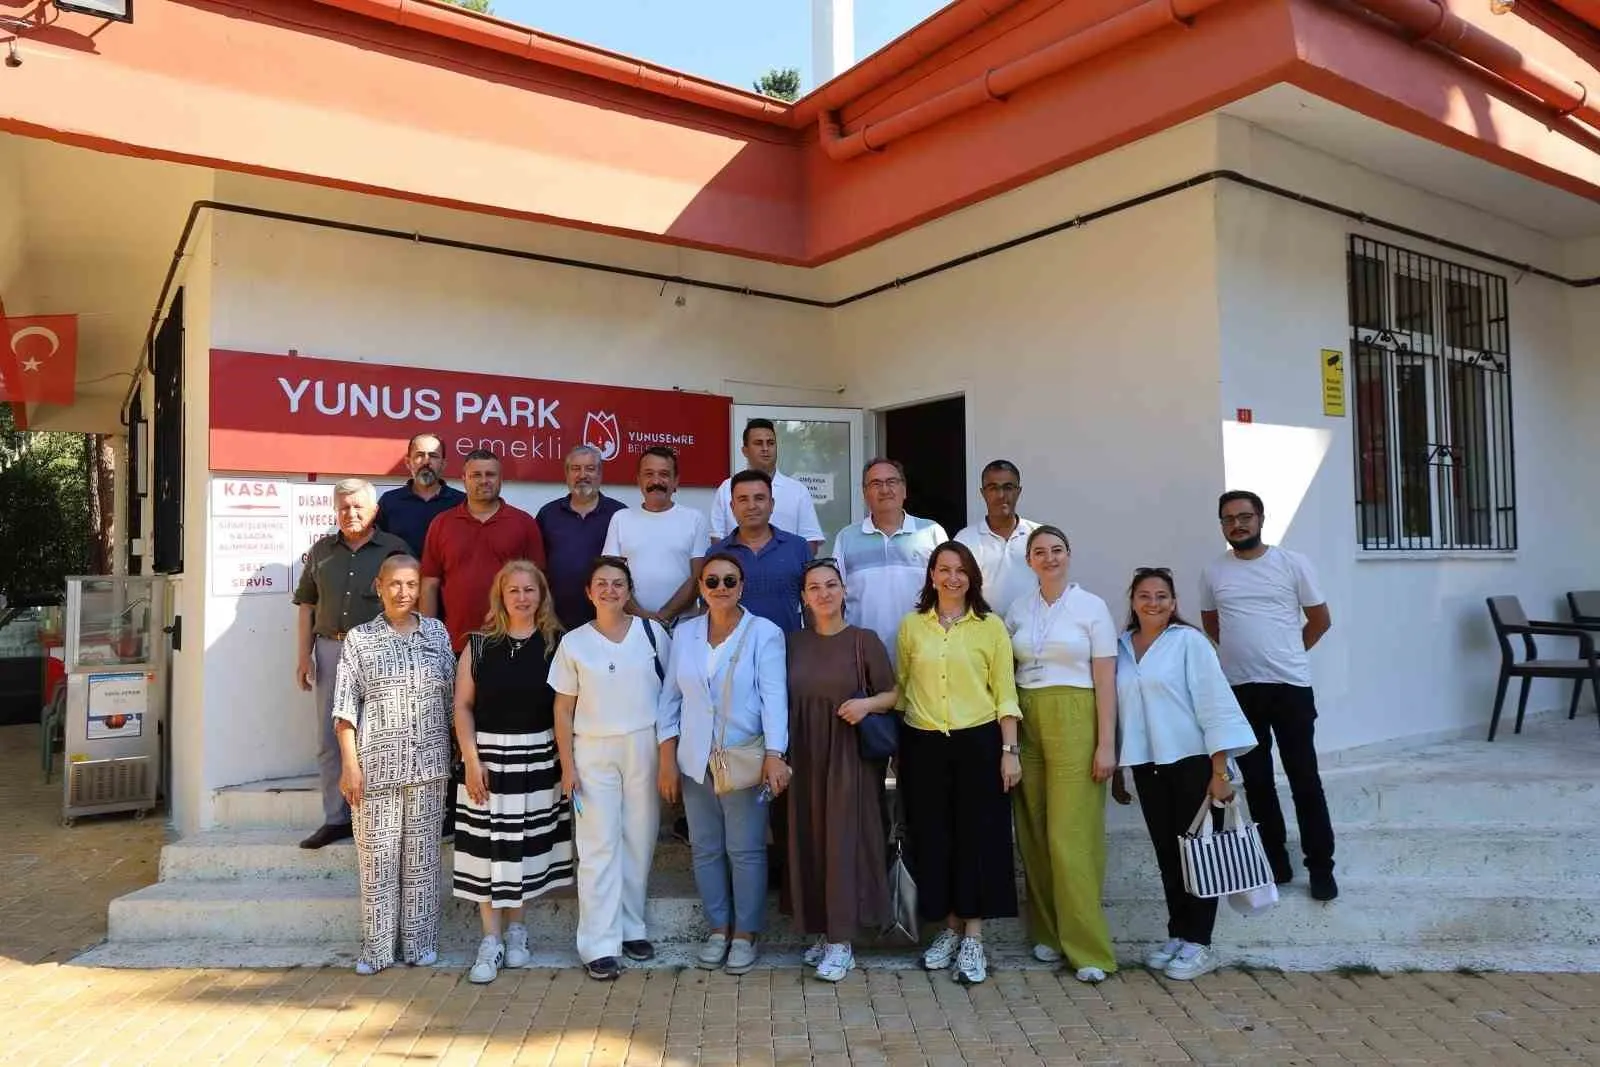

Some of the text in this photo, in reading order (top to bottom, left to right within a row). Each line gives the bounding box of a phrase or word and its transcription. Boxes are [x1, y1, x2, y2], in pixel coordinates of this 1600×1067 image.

[278, 377, 561, 429] YUNUS PARK
[628, 431, 694, 445] YUNUSEMRE
[456, 434, 561, 459] emekli
[224, 482, 278, 497] KASA
[239, 562, 266, 572] SELF
[231, 575, 273, 587] SERVİS
